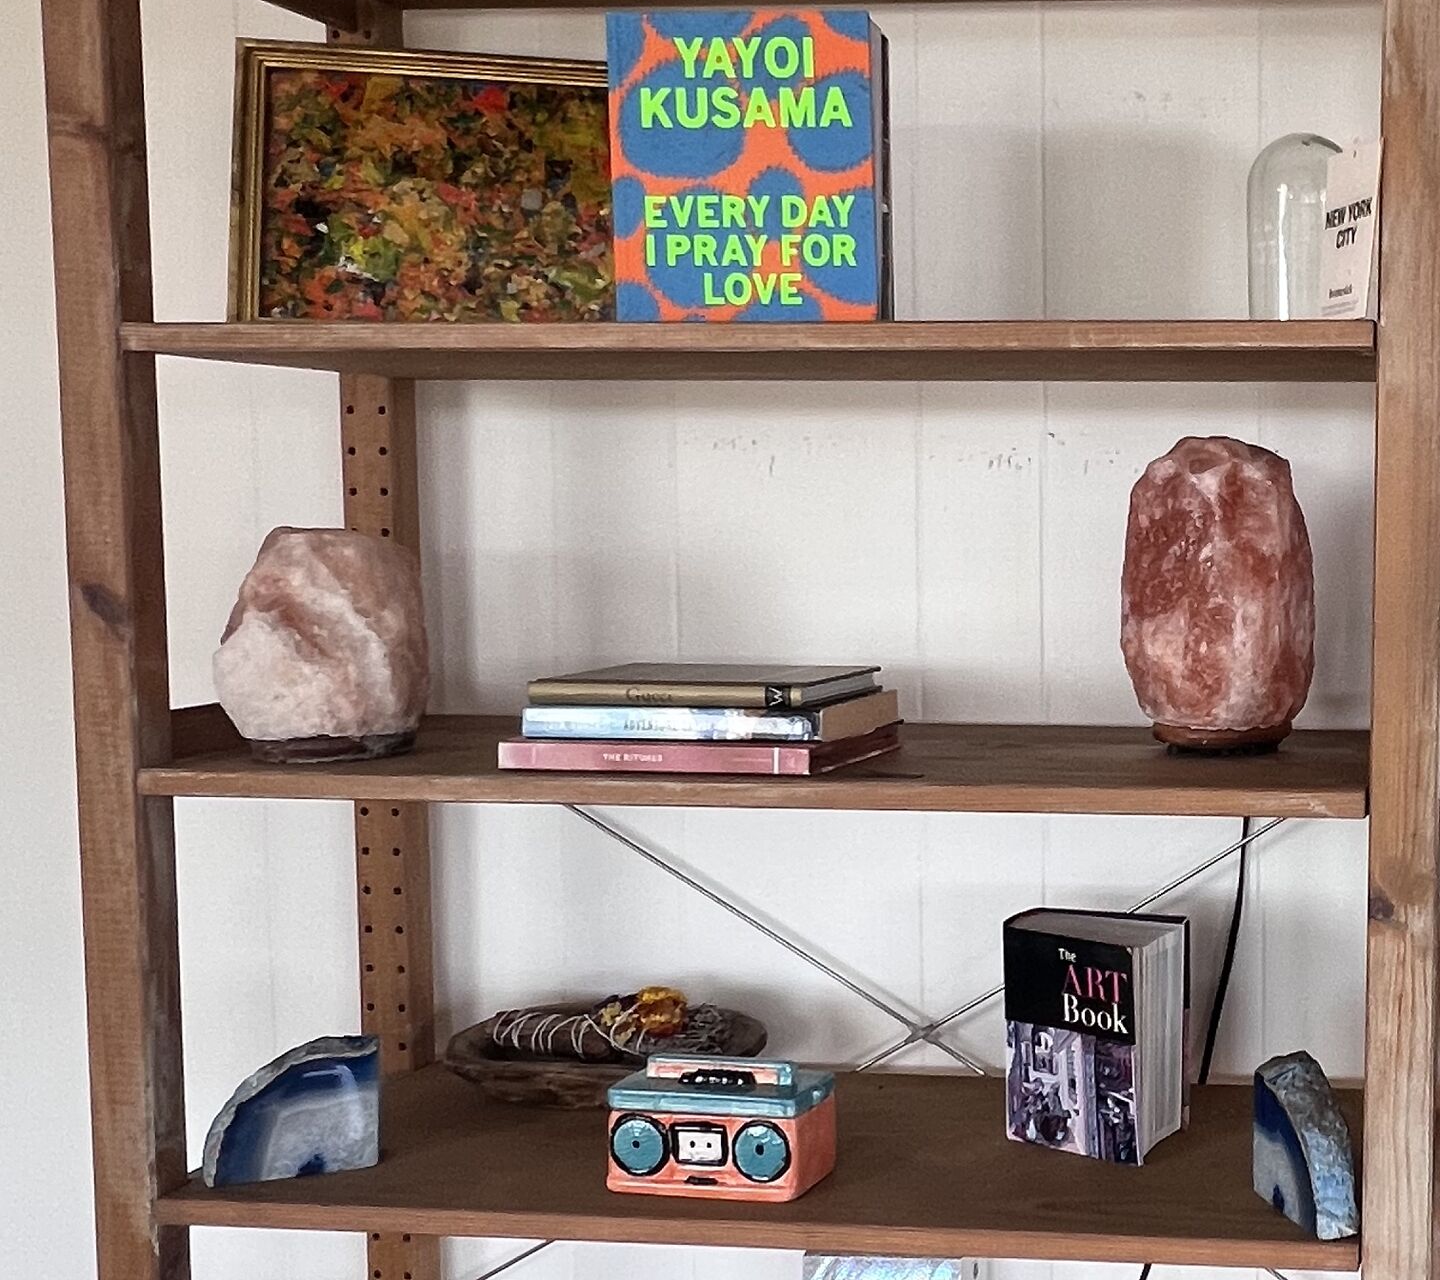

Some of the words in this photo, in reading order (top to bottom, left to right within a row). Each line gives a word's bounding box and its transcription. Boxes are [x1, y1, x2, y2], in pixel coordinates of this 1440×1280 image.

[673, 36, 815, 79] YAYOI
[640, 86, 853, 129] KUSAMA
[644, 195, 770, 229] EVERY
[781, 195, 855, 229] DAY
[1325, 207, 1347, 230] NEW
[1348, 197, 1373, 222] YORK
[645, 234, 656, 267] I
[666, 234, 769, 267] PRAY
[780, 233, 857, 267] FOR
[1335, 225, 1357, 249] CITY
[703, 272, 803, 306] LOVE
[603, 753, 621, 762] THE
[1058, 948, 1077, 963] The
[1063, 964, 1128, 1005] ART
[1063, 993, 1128, 1035] Book
